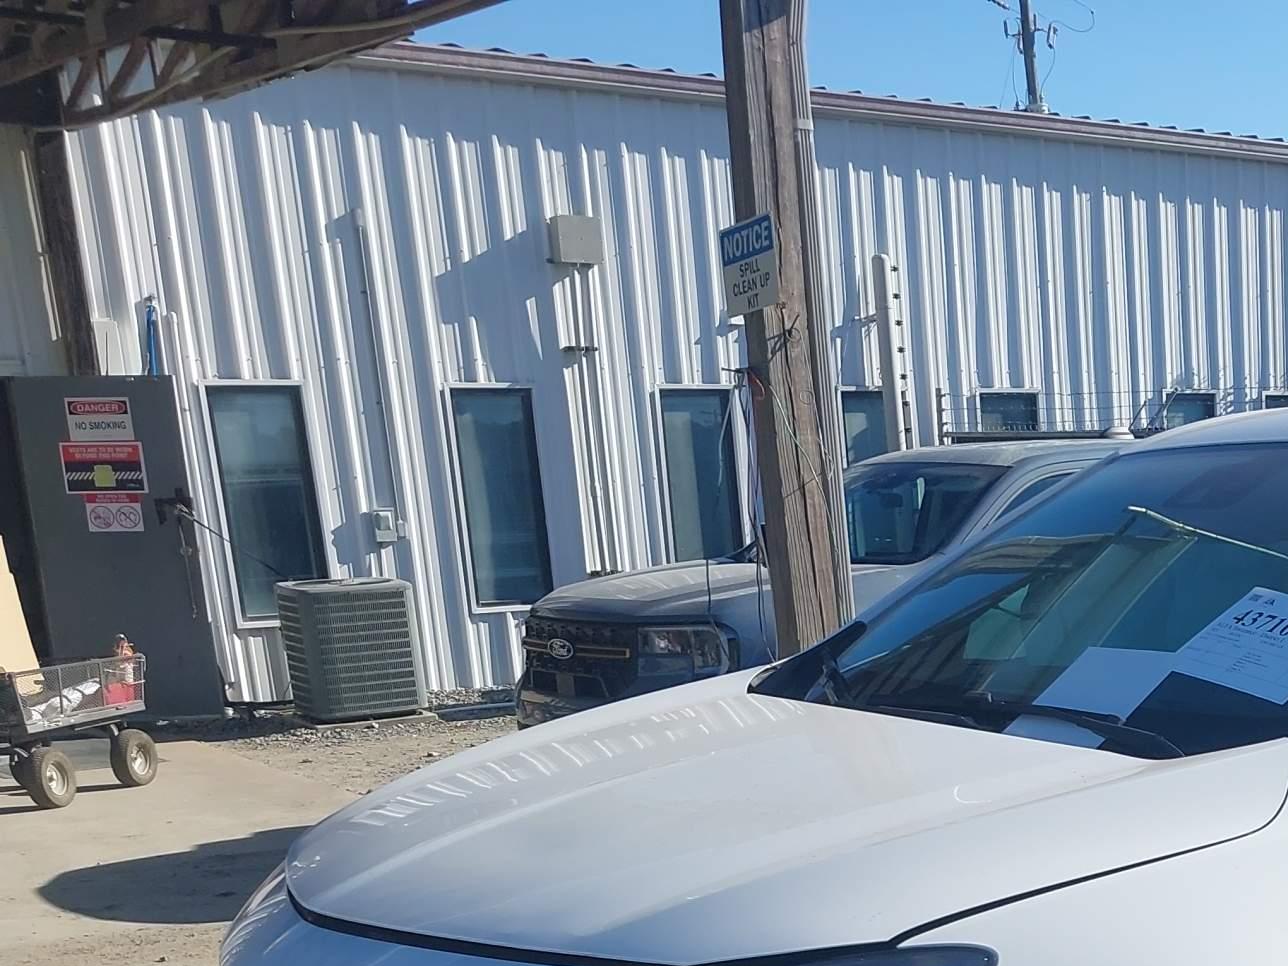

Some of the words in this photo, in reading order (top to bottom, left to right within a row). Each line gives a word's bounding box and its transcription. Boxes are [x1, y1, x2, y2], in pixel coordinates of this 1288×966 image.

[724, 221, 770, 261] NOTICE
[739, 258, 760, 278] SPILL
[732, 277, 758, 297] CLEAN
[759, 271, 770, 288] UP
[747, 293, 760, 310] KIT
[76, 403, 119, 412] DANGER
[75, 421, 87, 430] NO
[88, 421, 127, 430] SMOKING
